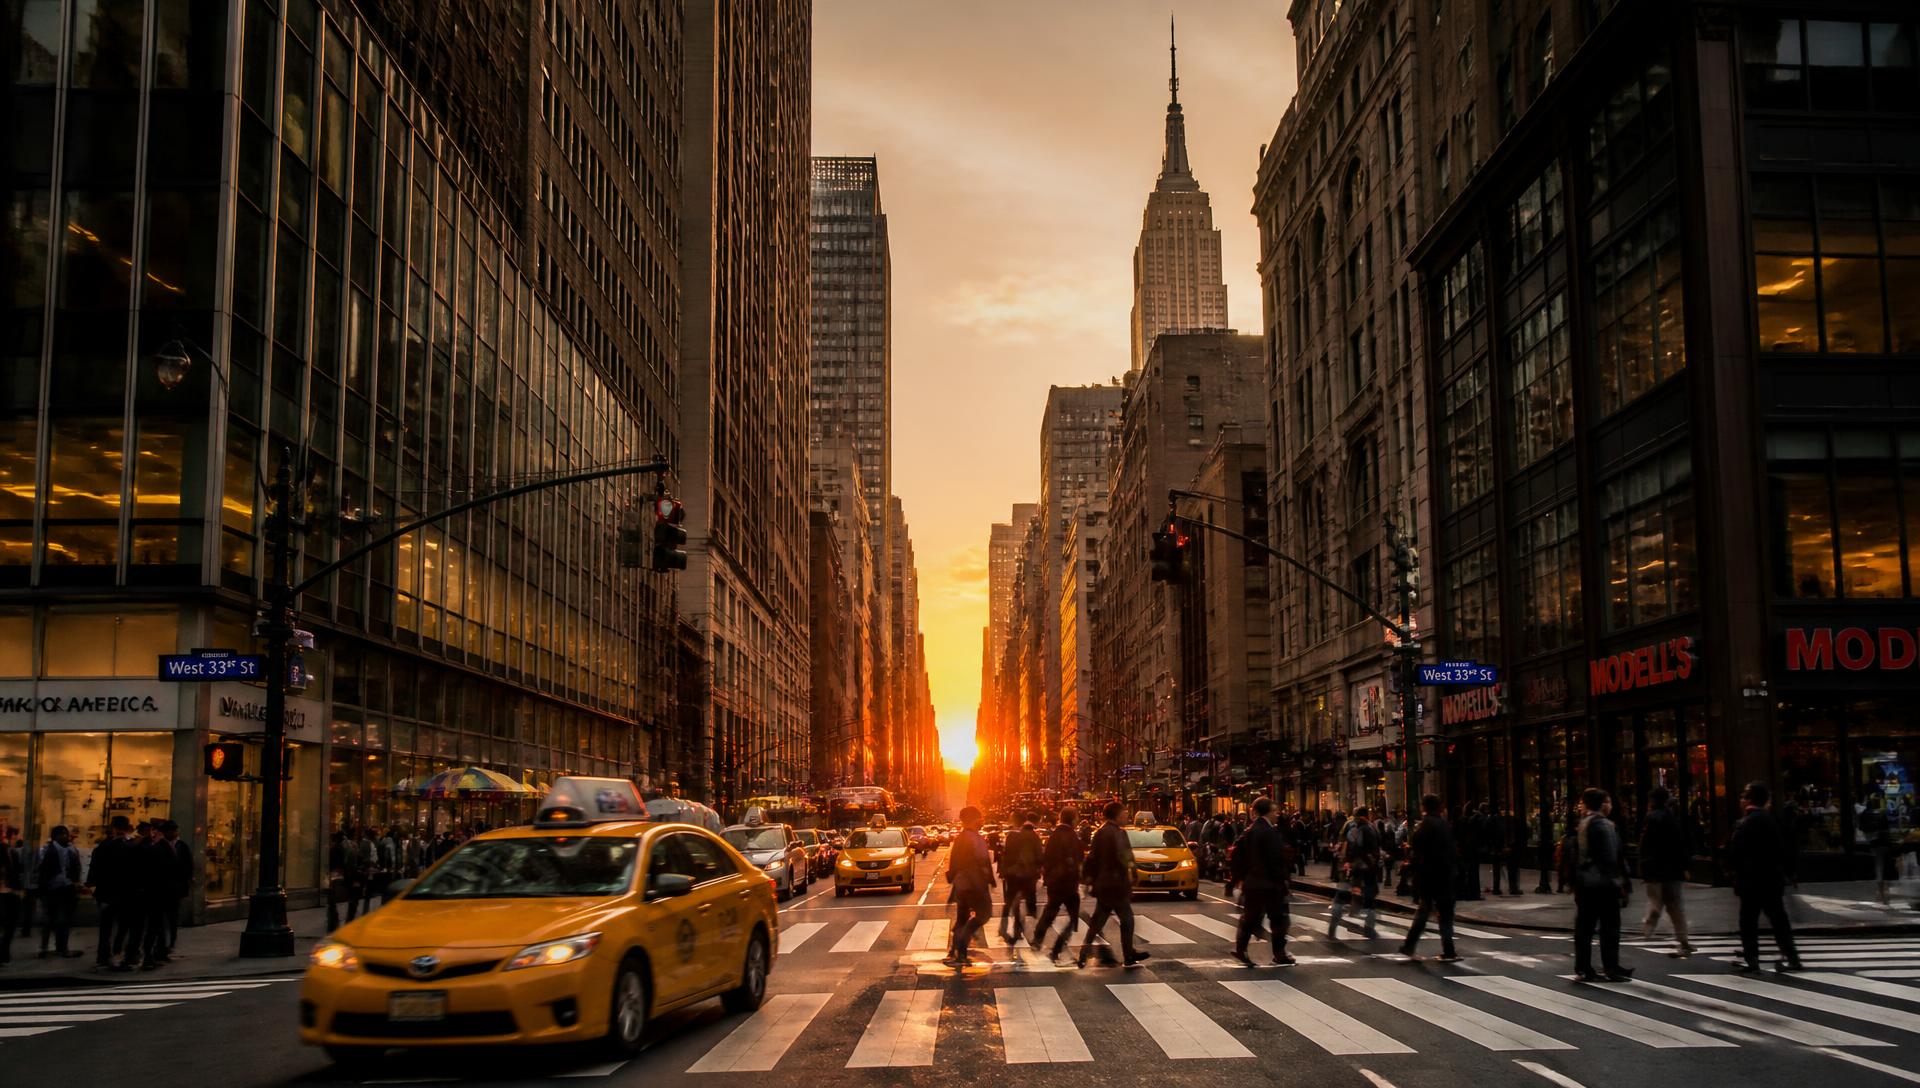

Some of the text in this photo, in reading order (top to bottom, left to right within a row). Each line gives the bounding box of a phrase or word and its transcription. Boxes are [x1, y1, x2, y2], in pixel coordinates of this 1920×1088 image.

[1785, 626, 1920, 671] MOD
[169, 661, 204, 675] West
[240, 660, 255, 675] St
[1423, 669, 1452, 681] West
[1479, 668, 1493, 681] St
[1589, 635, 1692, 697] MODELL'S
